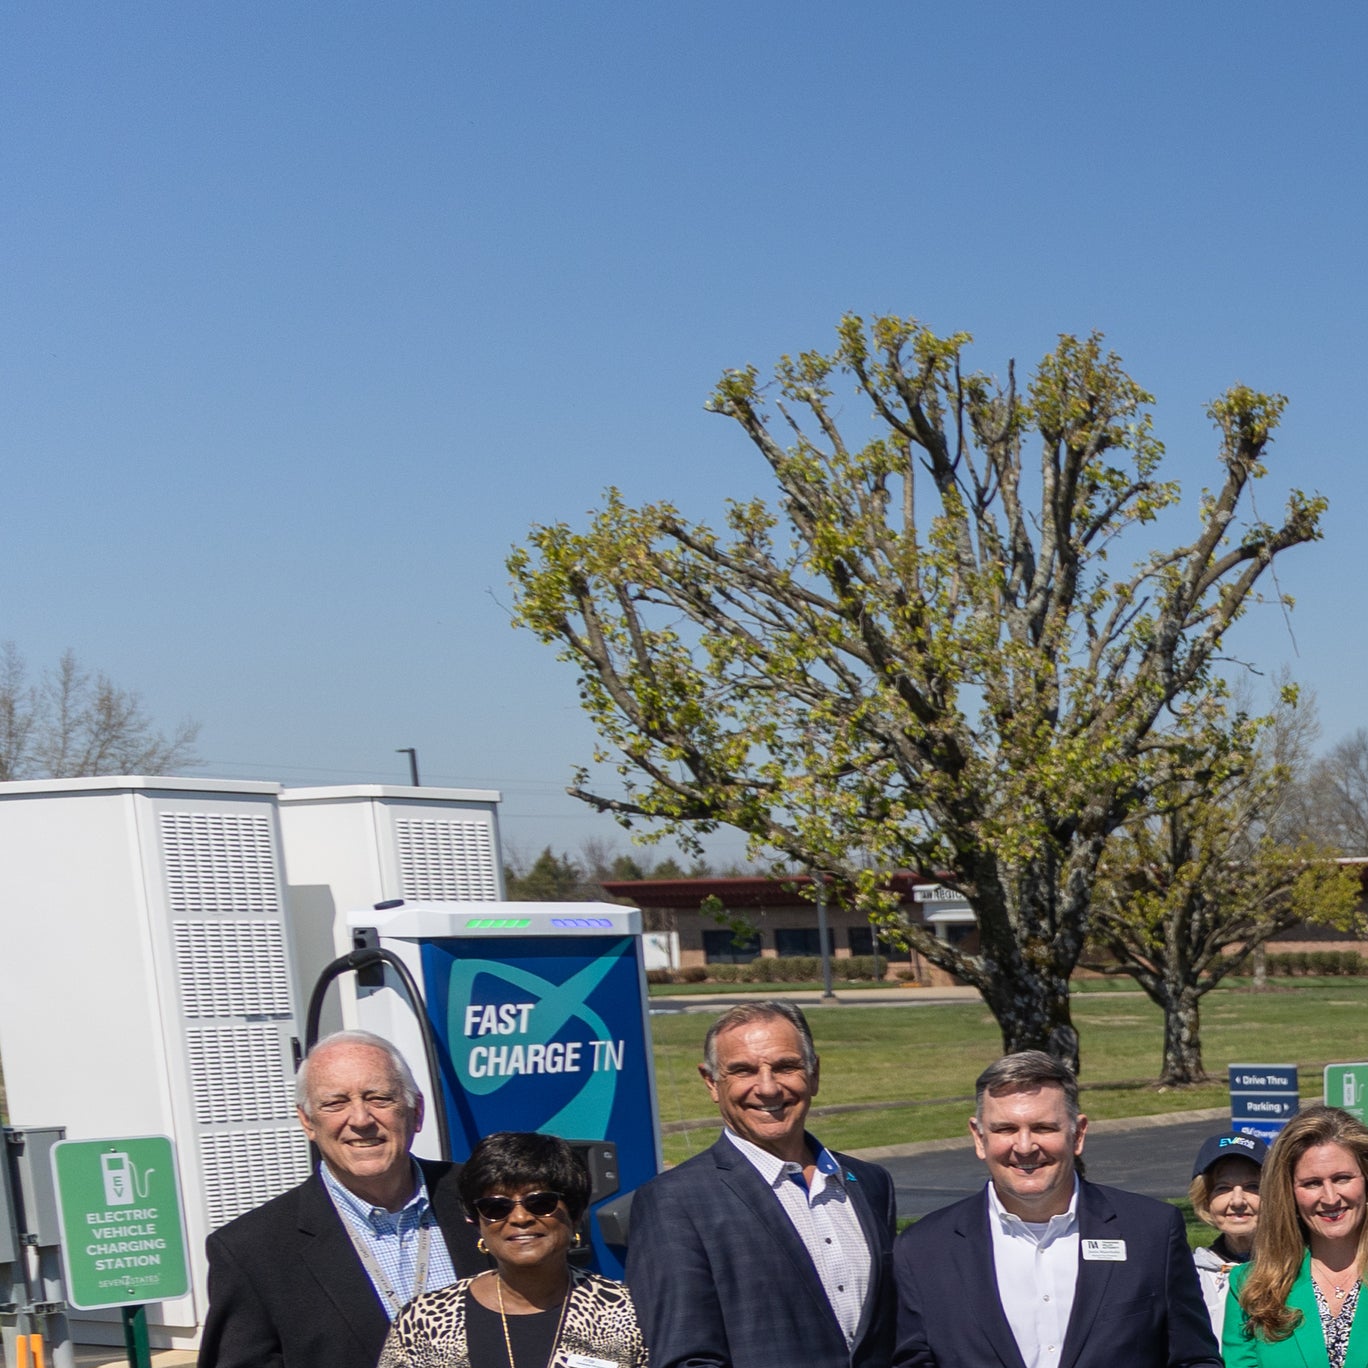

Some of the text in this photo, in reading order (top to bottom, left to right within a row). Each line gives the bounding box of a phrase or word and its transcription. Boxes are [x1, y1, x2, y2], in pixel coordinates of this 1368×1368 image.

[464, 1003, 535, 1036] FAST
[468, 1040, 625, 1078] CHARGE TN
[1242, 1076, 1288, 1085] Drive Thru
[1247, 1102, 1281, 1113] Parking
[86, 1208, 158, 1224] ELECTRIC
[92, 1224, 156, 1240] VEHICLE
[86, 1238, 166, 1256] CHARGING
[96, 1254, 160, 1270] STATION
